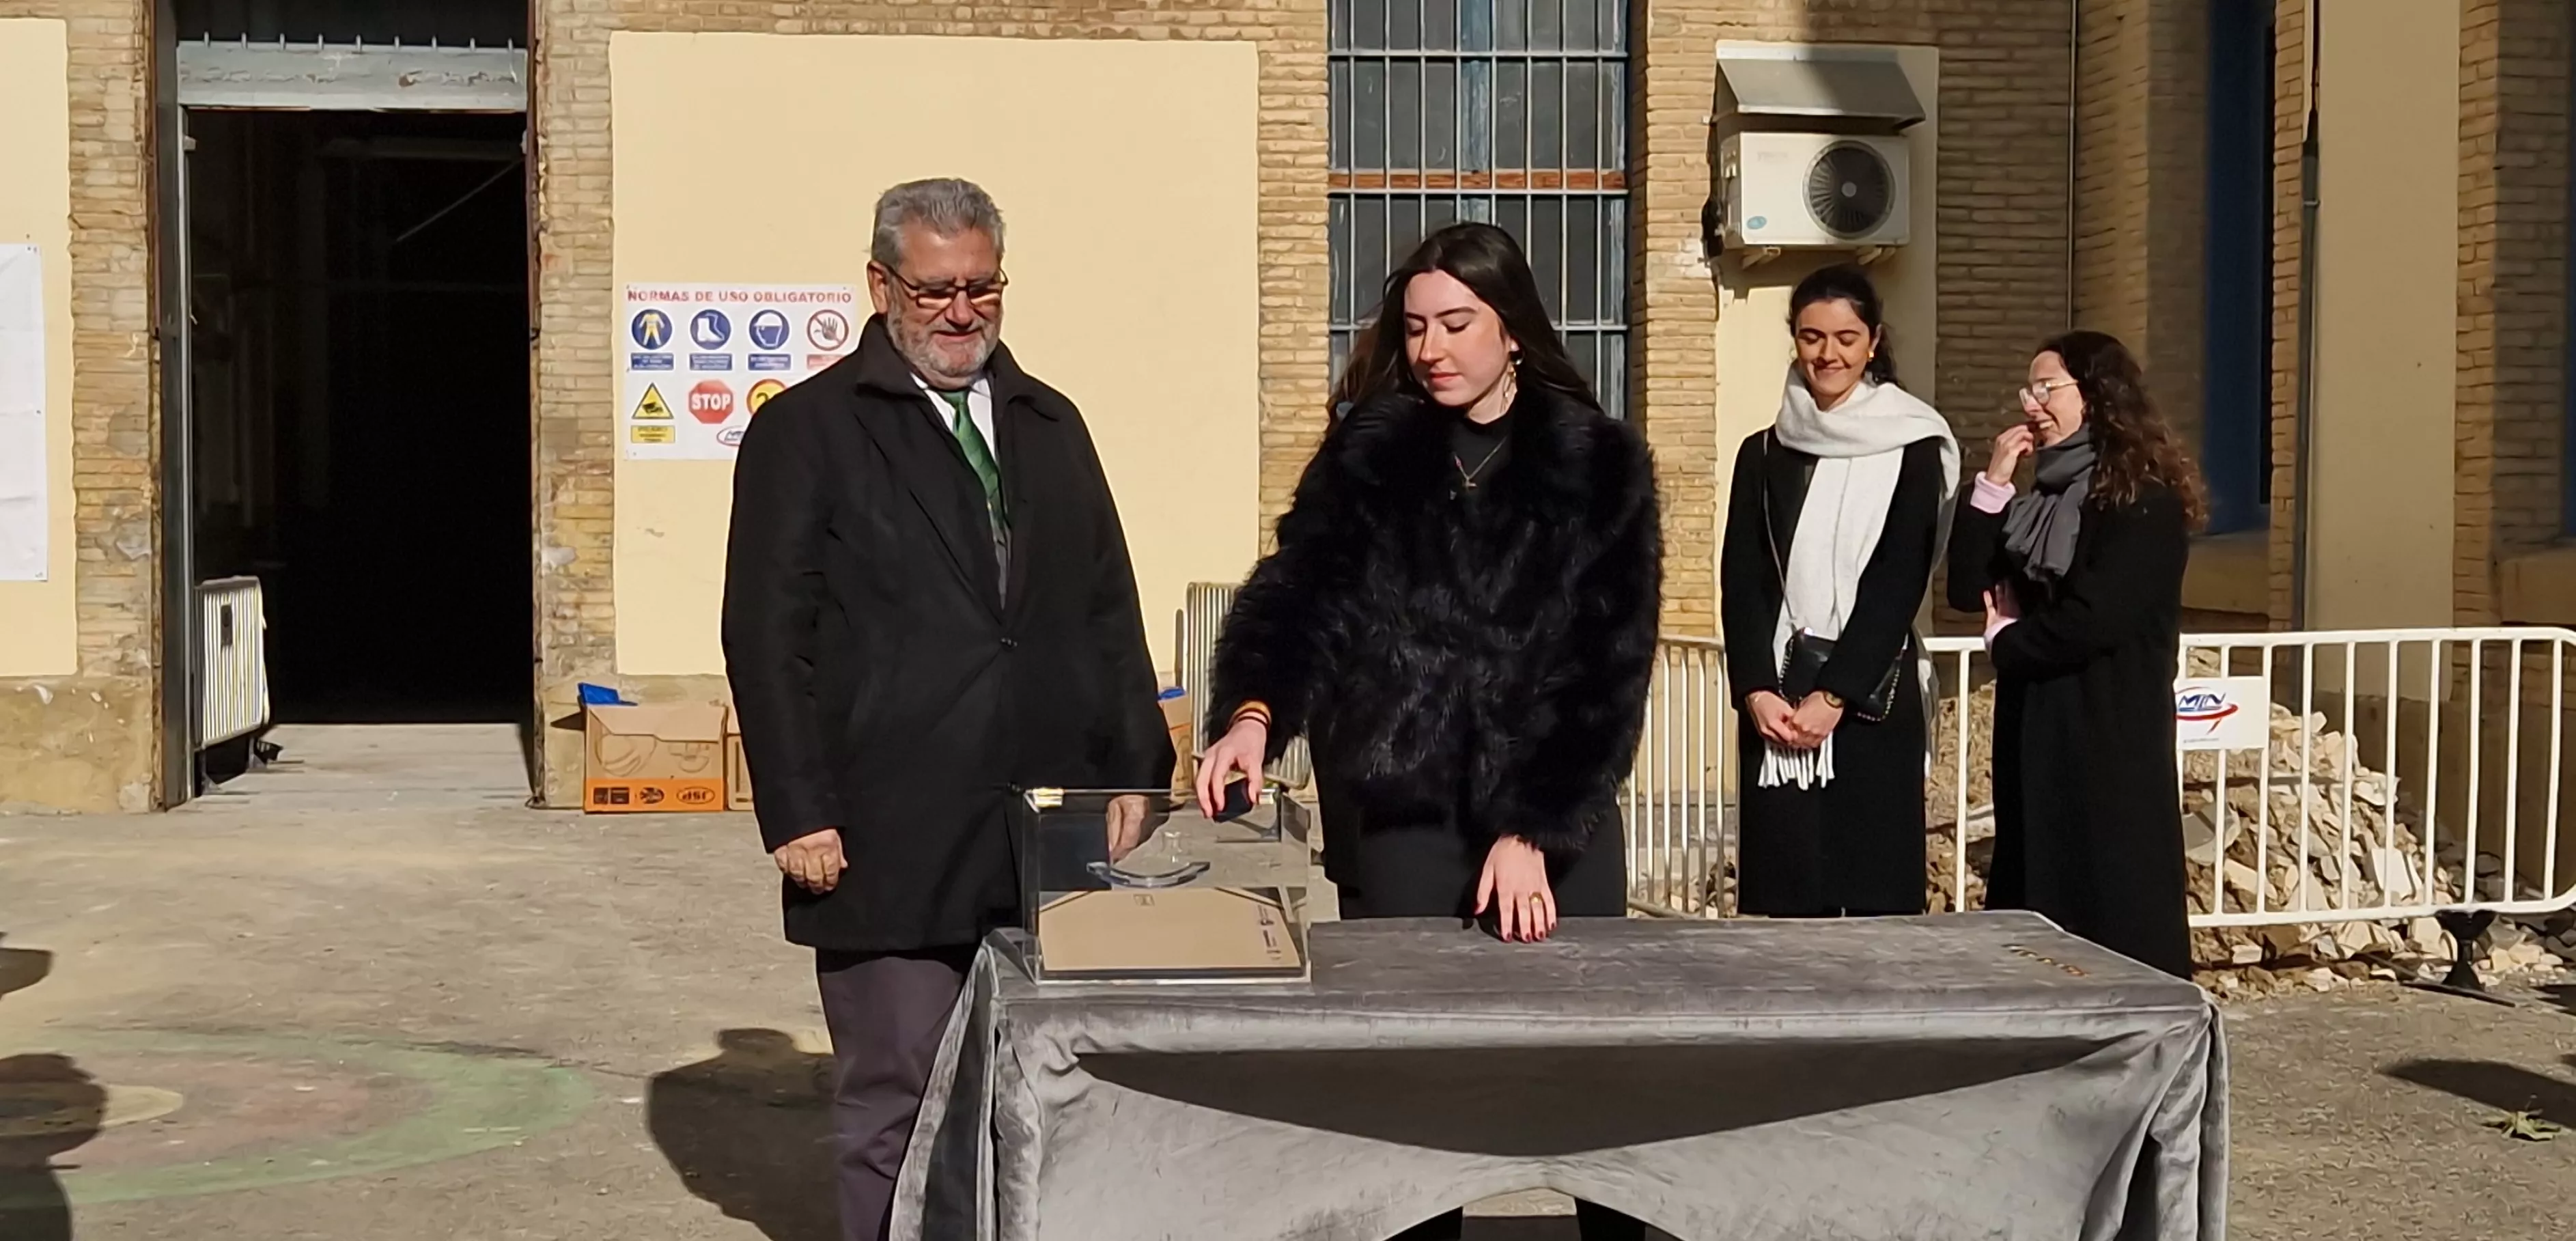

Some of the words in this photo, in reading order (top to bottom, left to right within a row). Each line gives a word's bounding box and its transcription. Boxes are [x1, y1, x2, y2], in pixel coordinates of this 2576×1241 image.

[628, 290, 689, 302] NORMAS
[695, 291, 713, 302] DE
[718, 291, 748, 303] USO
[753, 291, 852, 303] OBLIGATORIO
[691, 392, 731, 410] STOP
